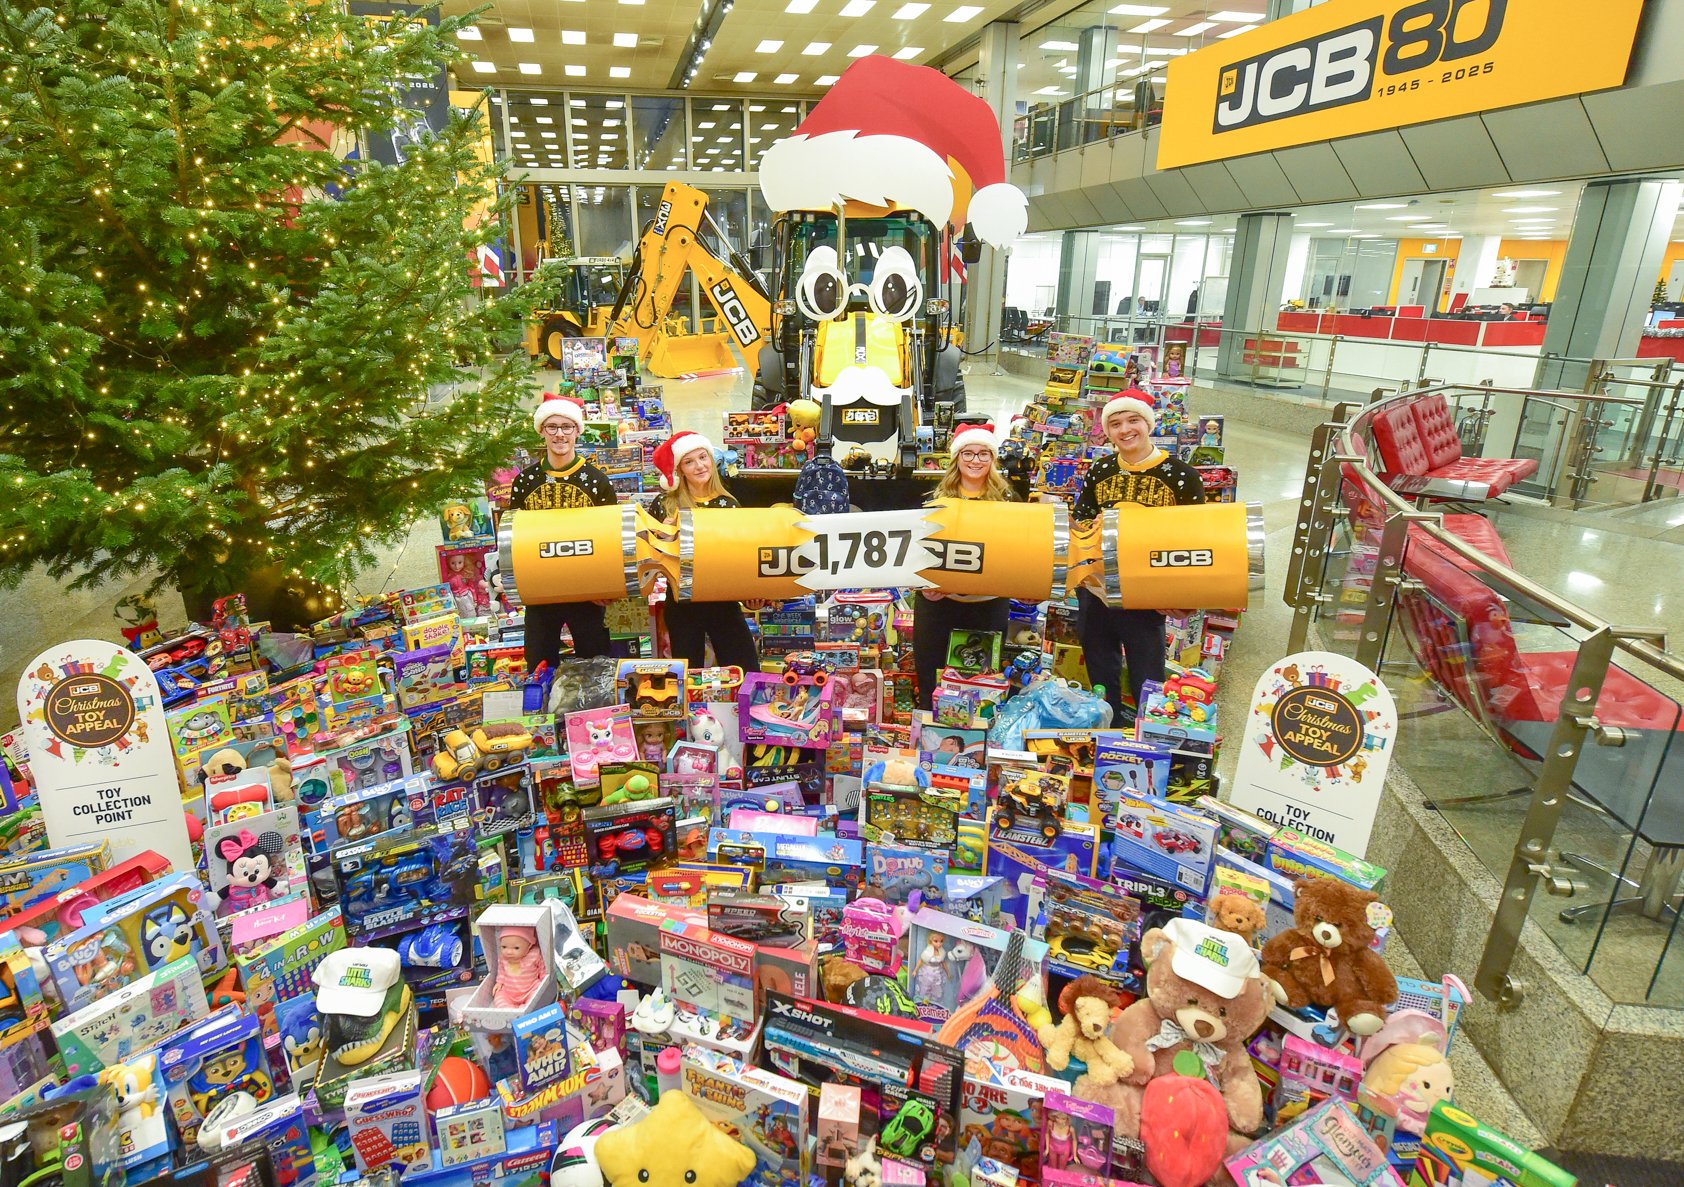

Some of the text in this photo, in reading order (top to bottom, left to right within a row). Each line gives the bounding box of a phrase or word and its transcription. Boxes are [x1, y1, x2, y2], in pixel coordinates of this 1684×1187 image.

[1218, 0, 1506, 126] JCB 80
[1377, 78, 1421, 97] 1945
[1441, 62, 1495, 84] 2025
[712, 284, 758, 346] JCB
[541, 541, 591, 557] JCB
[813, 529, 912, 575] 1,787
[1152, 550, 1212, 566] JCB
[830, 615, 852, 625] glow
[72, 684, 99, 694] JCB
[55, 698, 122, 715] Christmas
[1308, 697, 1336, 711] JCB
[75, 711, 105, 722] TOY
[1284, 702, 1352, 735] Christmas
[66, 720, 122, 734] APPEAL
[1299, 724, 1332, 740] TOY
[1284, 730, 1340, 756] APPEAL
[1098, 752, 1144, 763] ROCKET
[97, 788, 121, 800] TOY
[436, 788, 466, 805] RAT
[73, 795, 151, 816] COLLECTION
[437, 800, 468, 818] RACE
[1286, 804, 1311, 821] TOY
[95, 810, 133, 824] POINT
[1256, 807, 1335, 844] COLLECTION
[873, 855, 923, 873] Donut
[1115, 877, 1165, 898] TRIPL3
[364, 905, 404, 926] BATTLE
[365, 912, 414, 931] BLASTER
[724, 908, 756, 917] SPEED
[261, 929, 335, 980] 4 IN A ROW
[665, 936, 747, 970] MONOPOLY
[1194, 944, 1229, 967] SHARKS
[1202, 937, 1228, 956] LITTLE
[346, 967, 371, 978] LITTLE
[339, 977, 372, 988] SHARKS
[517, 1017, 538, 1029] WHO
[538, 1012, 551, 1021] AM
[524, 1048, 566, 1072] WHO
[526, 1058, 567, 1086] AM I?
[686, 1068, 746, 1099] FRANTIC
[510, 1071, 587, 1117] HOT WHEELS
[978, 1086, 1008, 1105] ARE
[507, 1152, 547, 1167] Carrera
